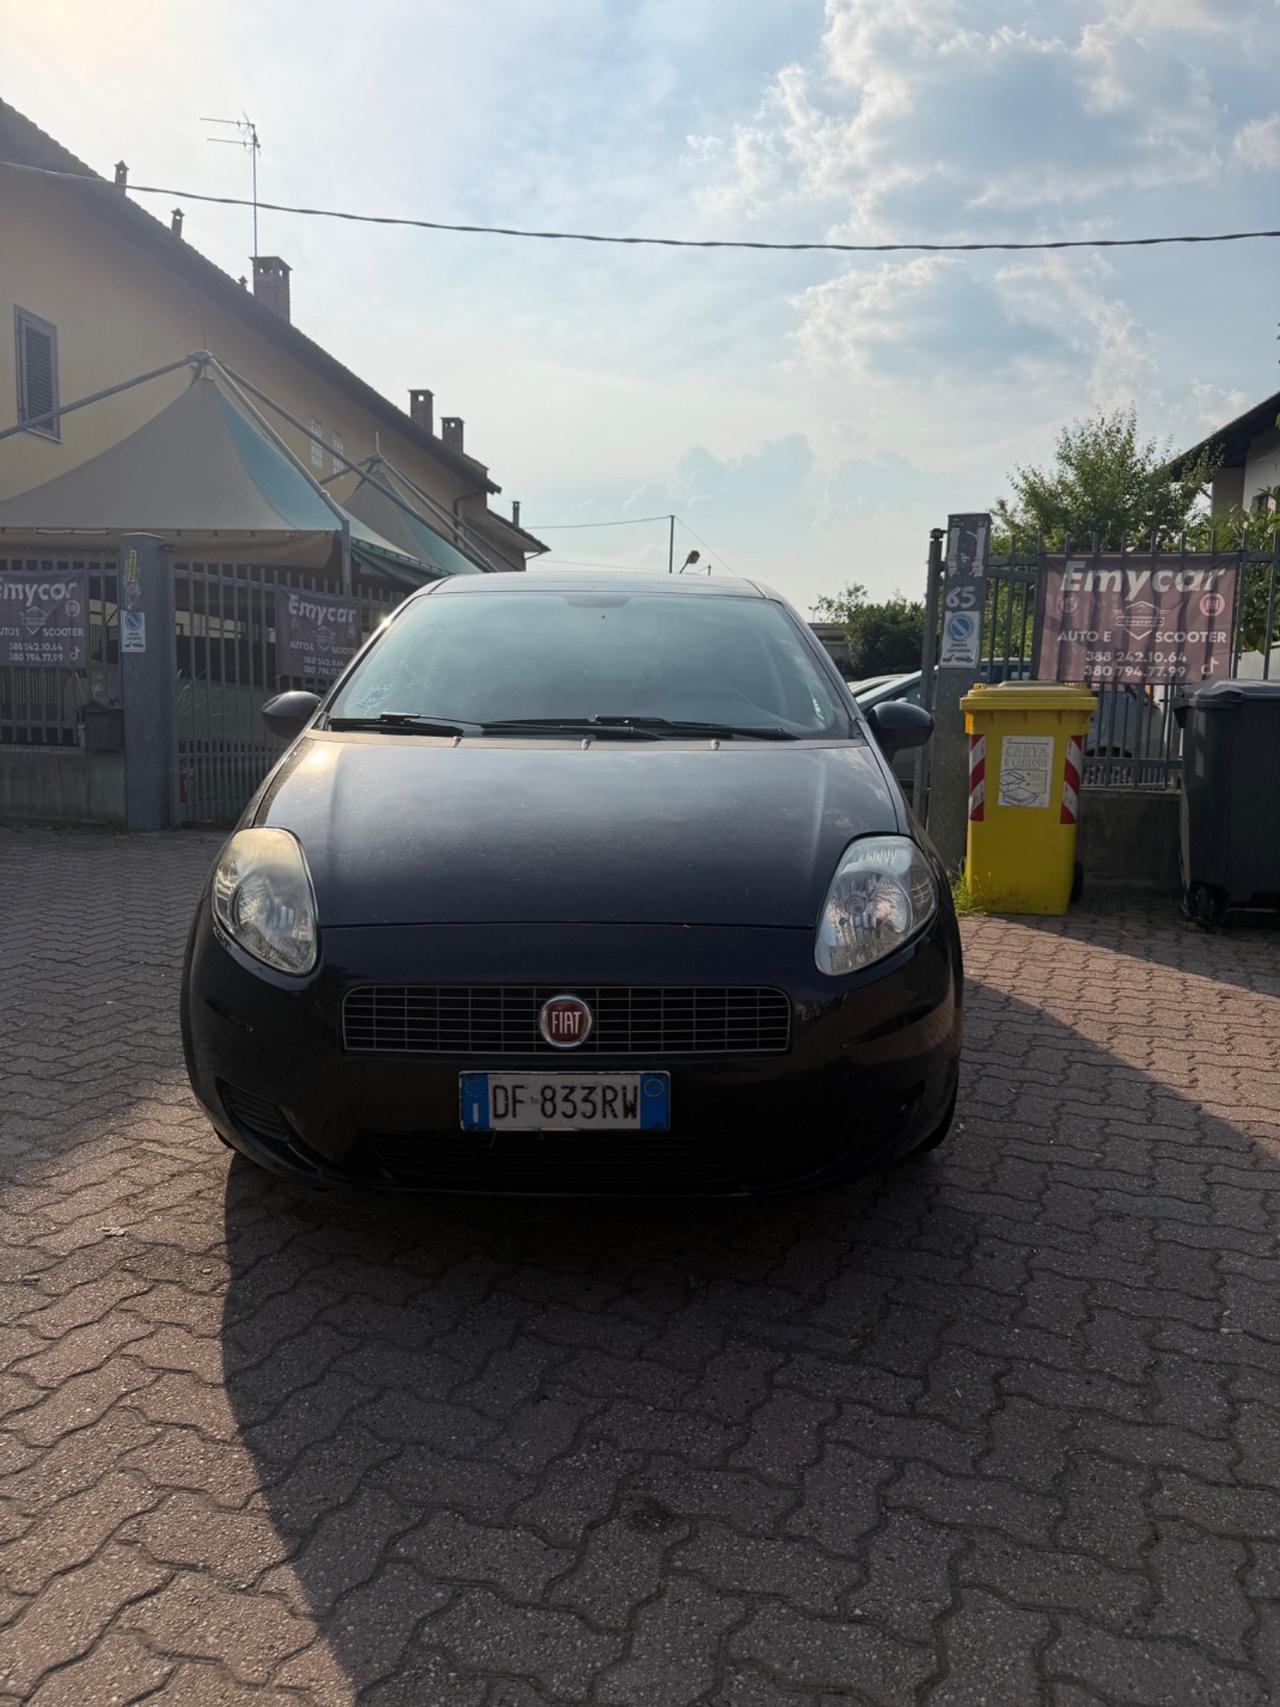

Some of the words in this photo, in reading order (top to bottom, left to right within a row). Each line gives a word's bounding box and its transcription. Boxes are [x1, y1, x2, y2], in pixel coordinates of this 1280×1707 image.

[0, 576, 78, 607] mycar
[1060, 560, 1226, 601] Emycar
[946, 586, 976, 608] 65
[288, 593, 356, 625] Emycar
[42, 627, 84, 637] SCOOTER
[1057, 631, 1098, 642] AUTO
[1103, 631, 1112, 642] E
[1155, 631, 1227, 643] SCOOTER
[1086, 651, 1111, 662] 388
[1116, 651, 1187, 663] 242.10.64
[1084, 665, 1112, 677] 380
[1116, 665, 1186, 677] 794.77.99
[551, 1011, 582, 1034] FIAT
[492, 1084, 528, 1119] DF
[540, 1084, 639, 1119] 833RW
